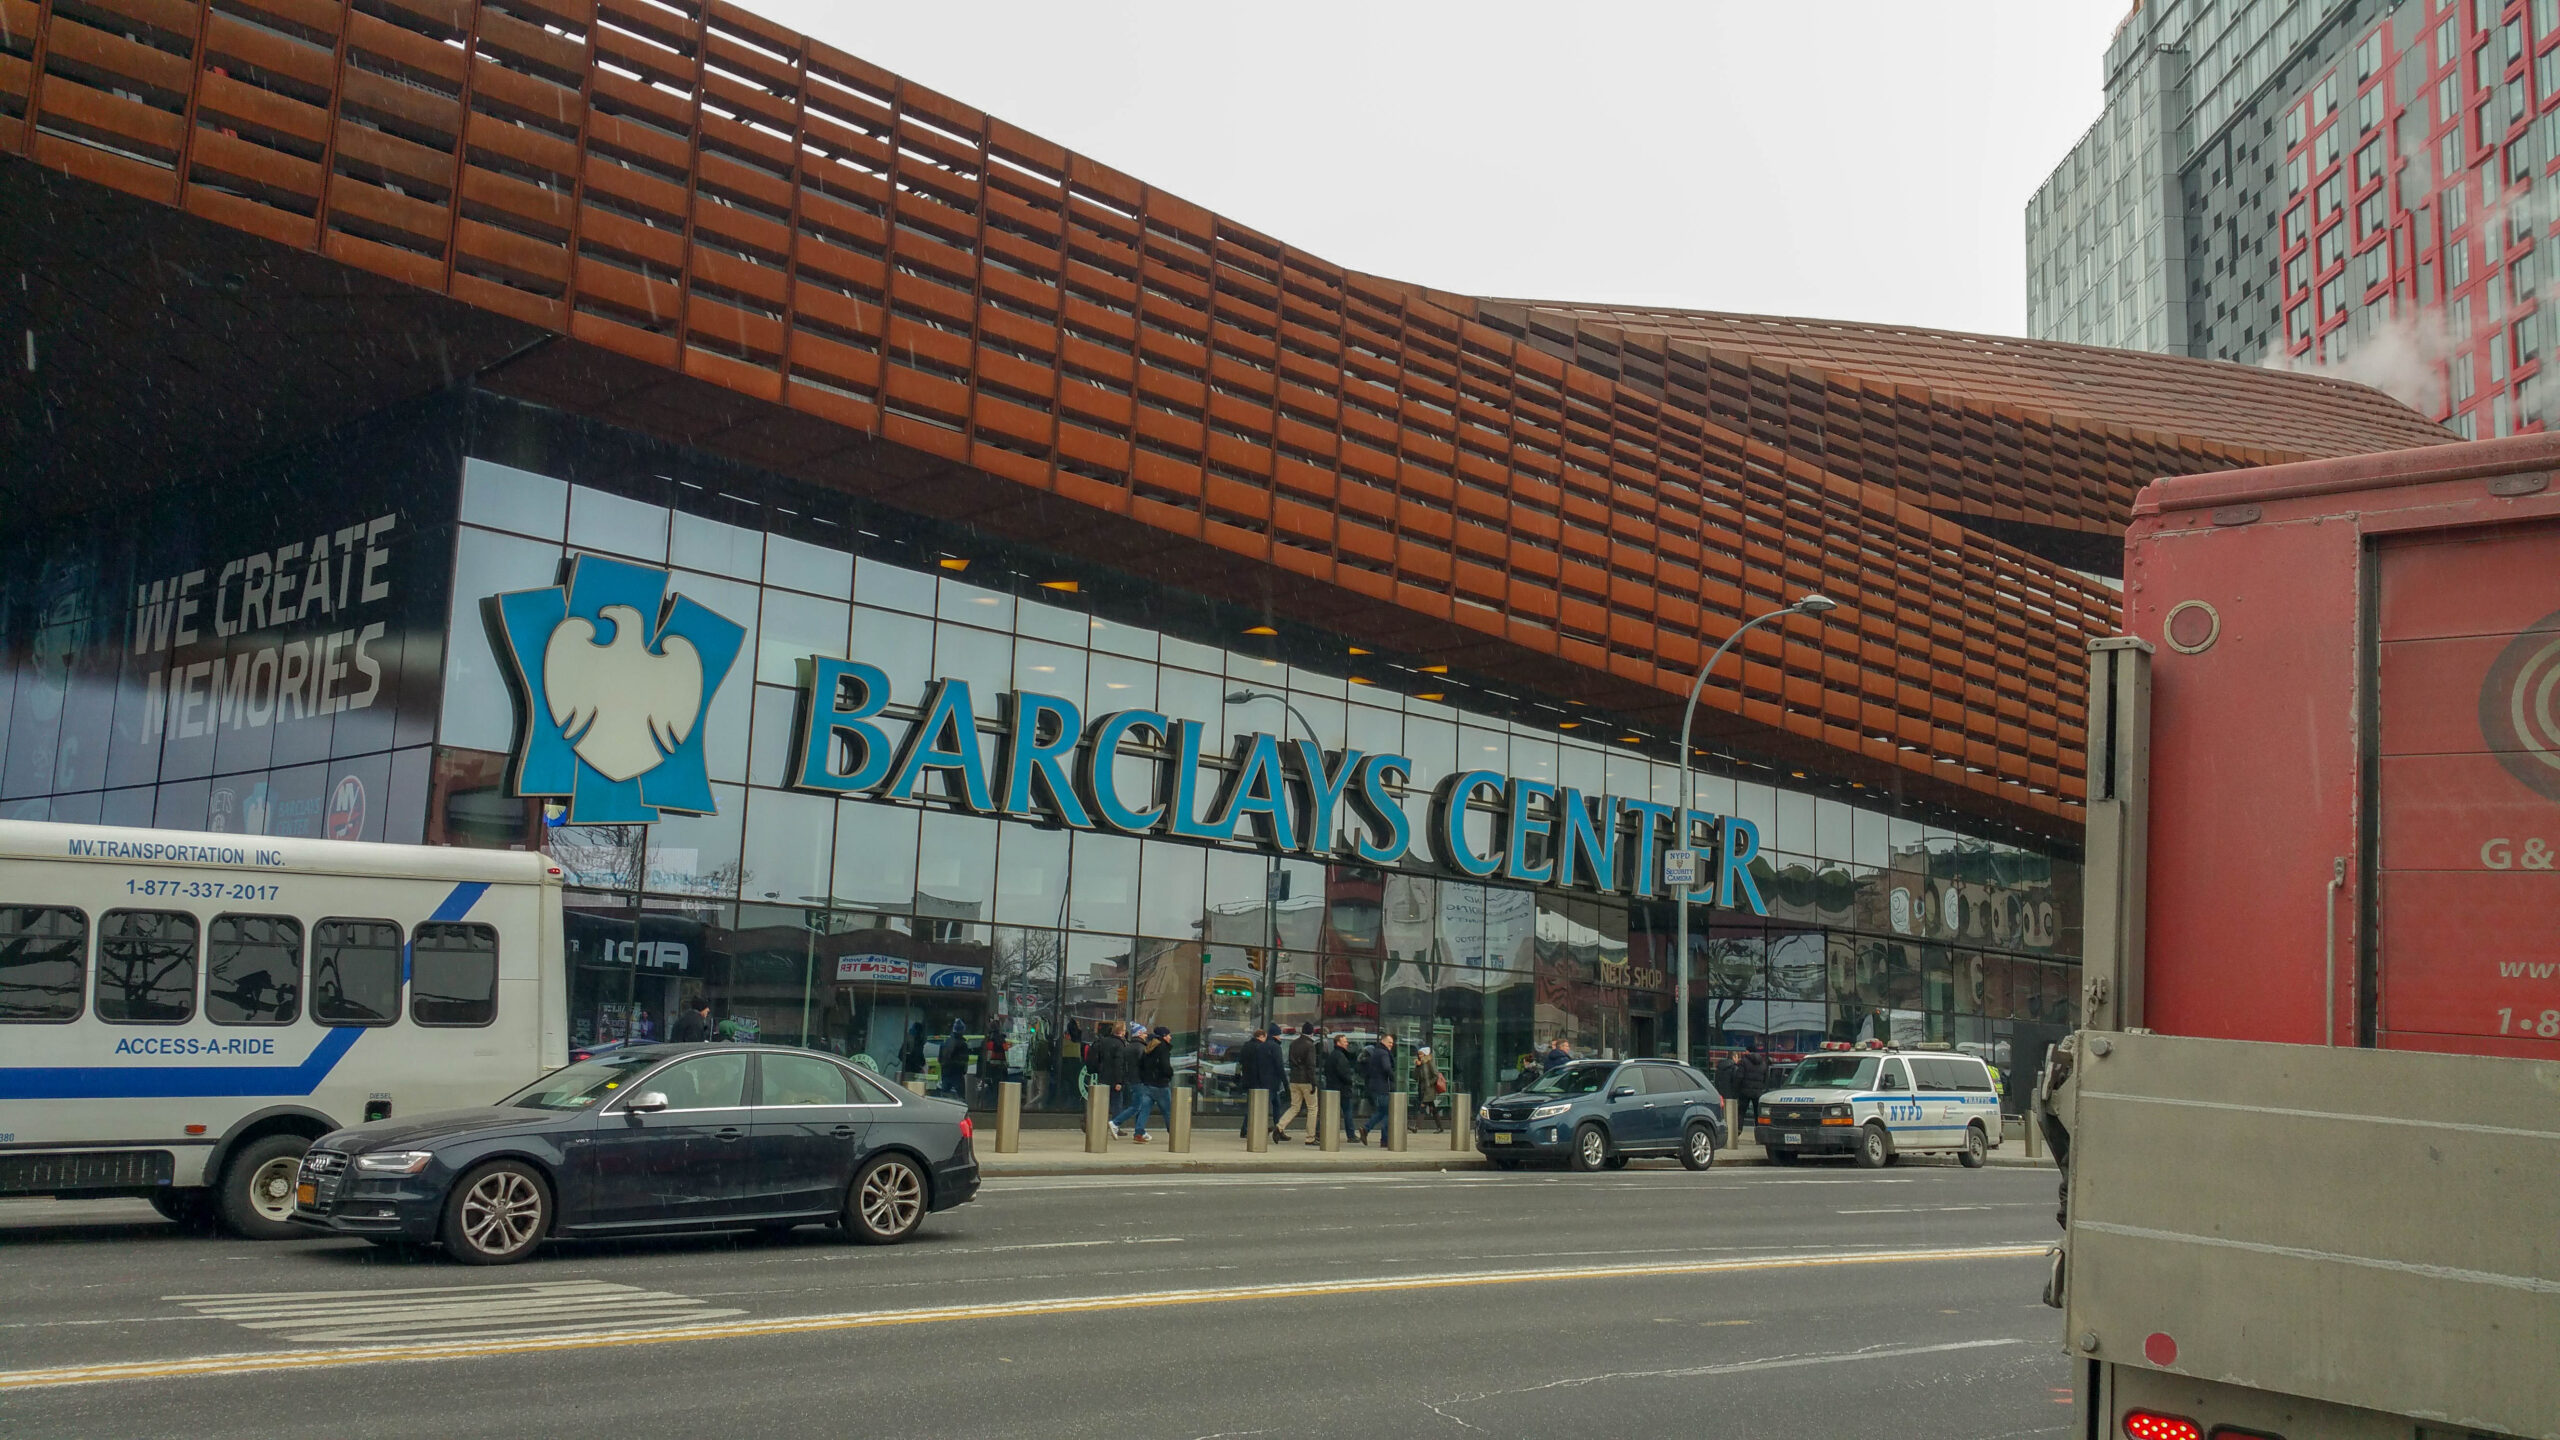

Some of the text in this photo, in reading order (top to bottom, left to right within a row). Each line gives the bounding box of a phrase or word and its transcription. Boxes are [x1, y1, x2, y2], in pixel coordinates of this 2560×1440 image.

[135, 513, 396, 655] WE CREATE
[141, 622, 385, 744] MEMORIES
[792, 654, 1770, 916] BARCLAYS CENTER
[255, 850, 286, 866] INC.
[1670, 852, 1690, 860] NYPD
[1667, 874, 1693, 882] CAMERA
[126, 879, 280, 901] 1-877-337-2017
[1600, 962, 1662, 988] NETS SHOP
[115, 1038, 274, 1055] ACCESS-A-RIDE
[1890, 1105, 1923, 1121] NYPD
